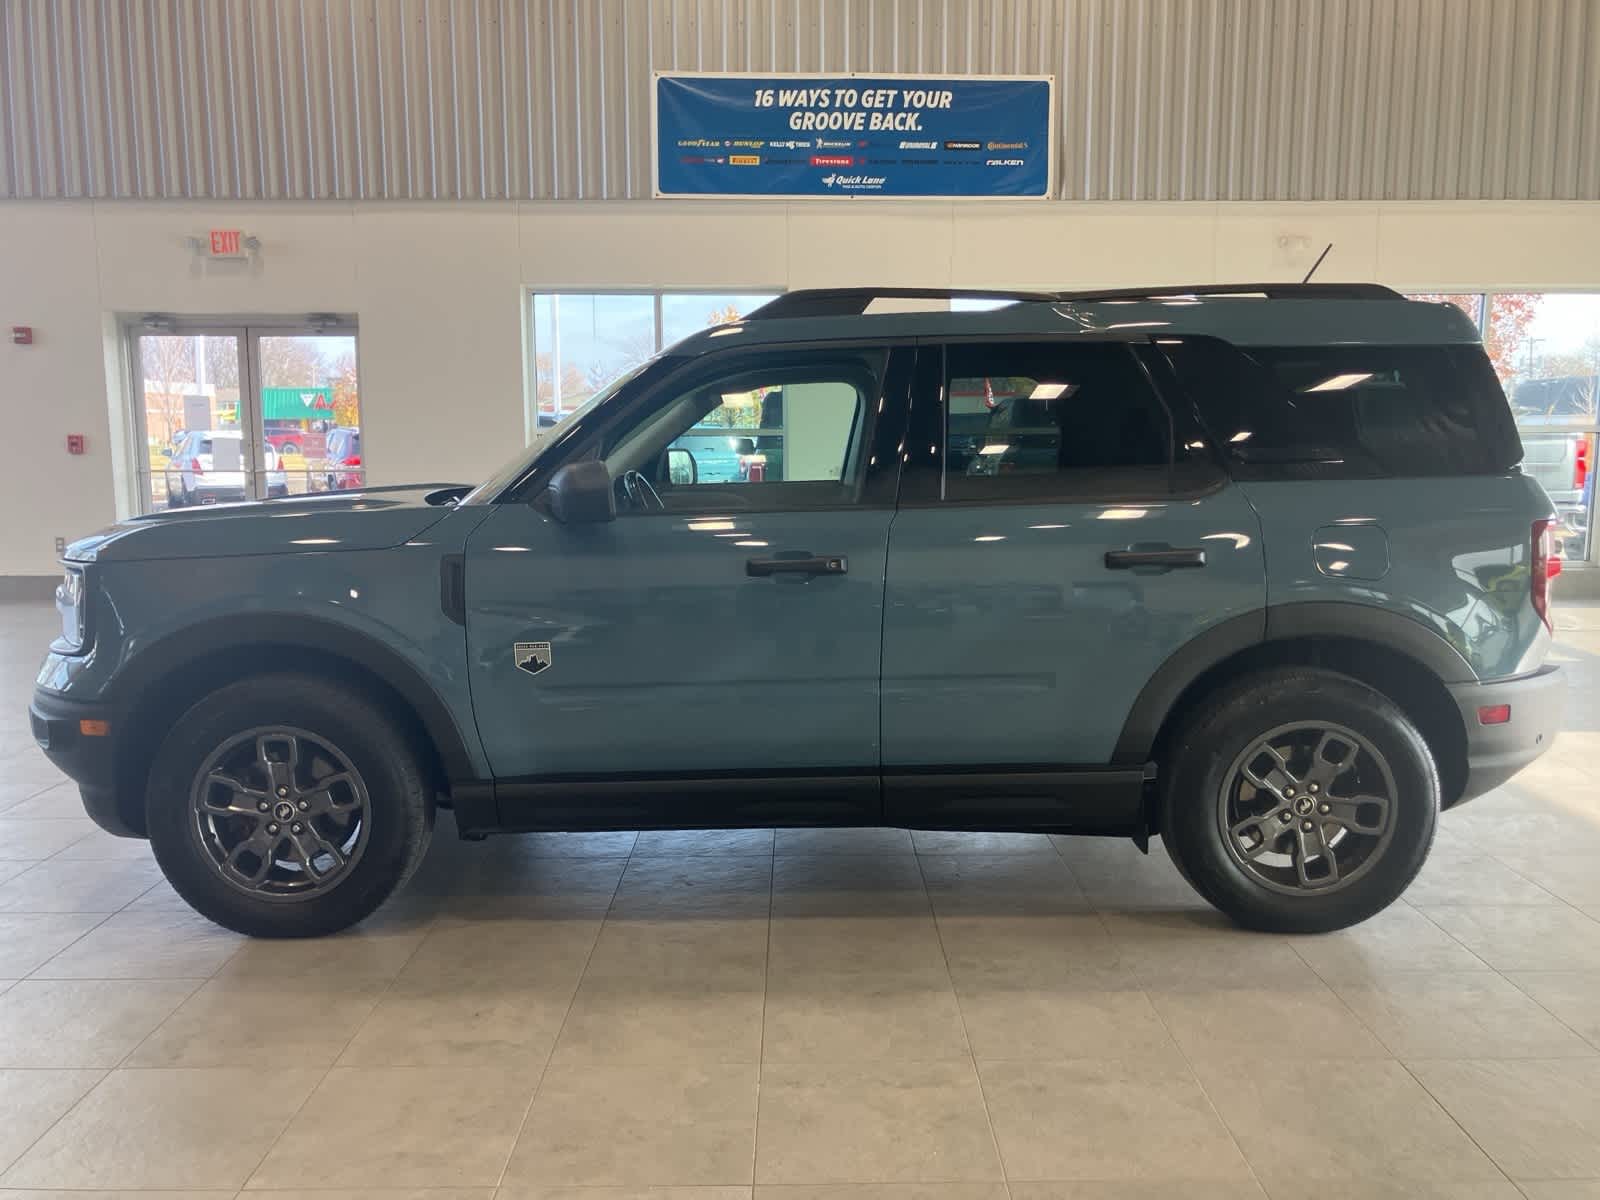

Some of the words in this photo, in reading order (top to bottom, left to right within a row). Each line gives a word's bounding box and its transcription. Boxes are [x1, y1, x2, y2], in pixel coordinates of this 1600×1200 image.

[754, 89, 774, 107] 16
[778, 89, 831, 108] WAYS
[834, 89, 858, 108] TO
[861, 89, 898, 108] GET
[903, 90, 953, 108] YOUR
[789, 112, 866, 131] GROOVE
[869, 112, 923, 131] BACK.
[836, 175, 861, 185] Quick
[862, 175, 886, 185] Lane
[210, 230, 240, 254] EXIT
